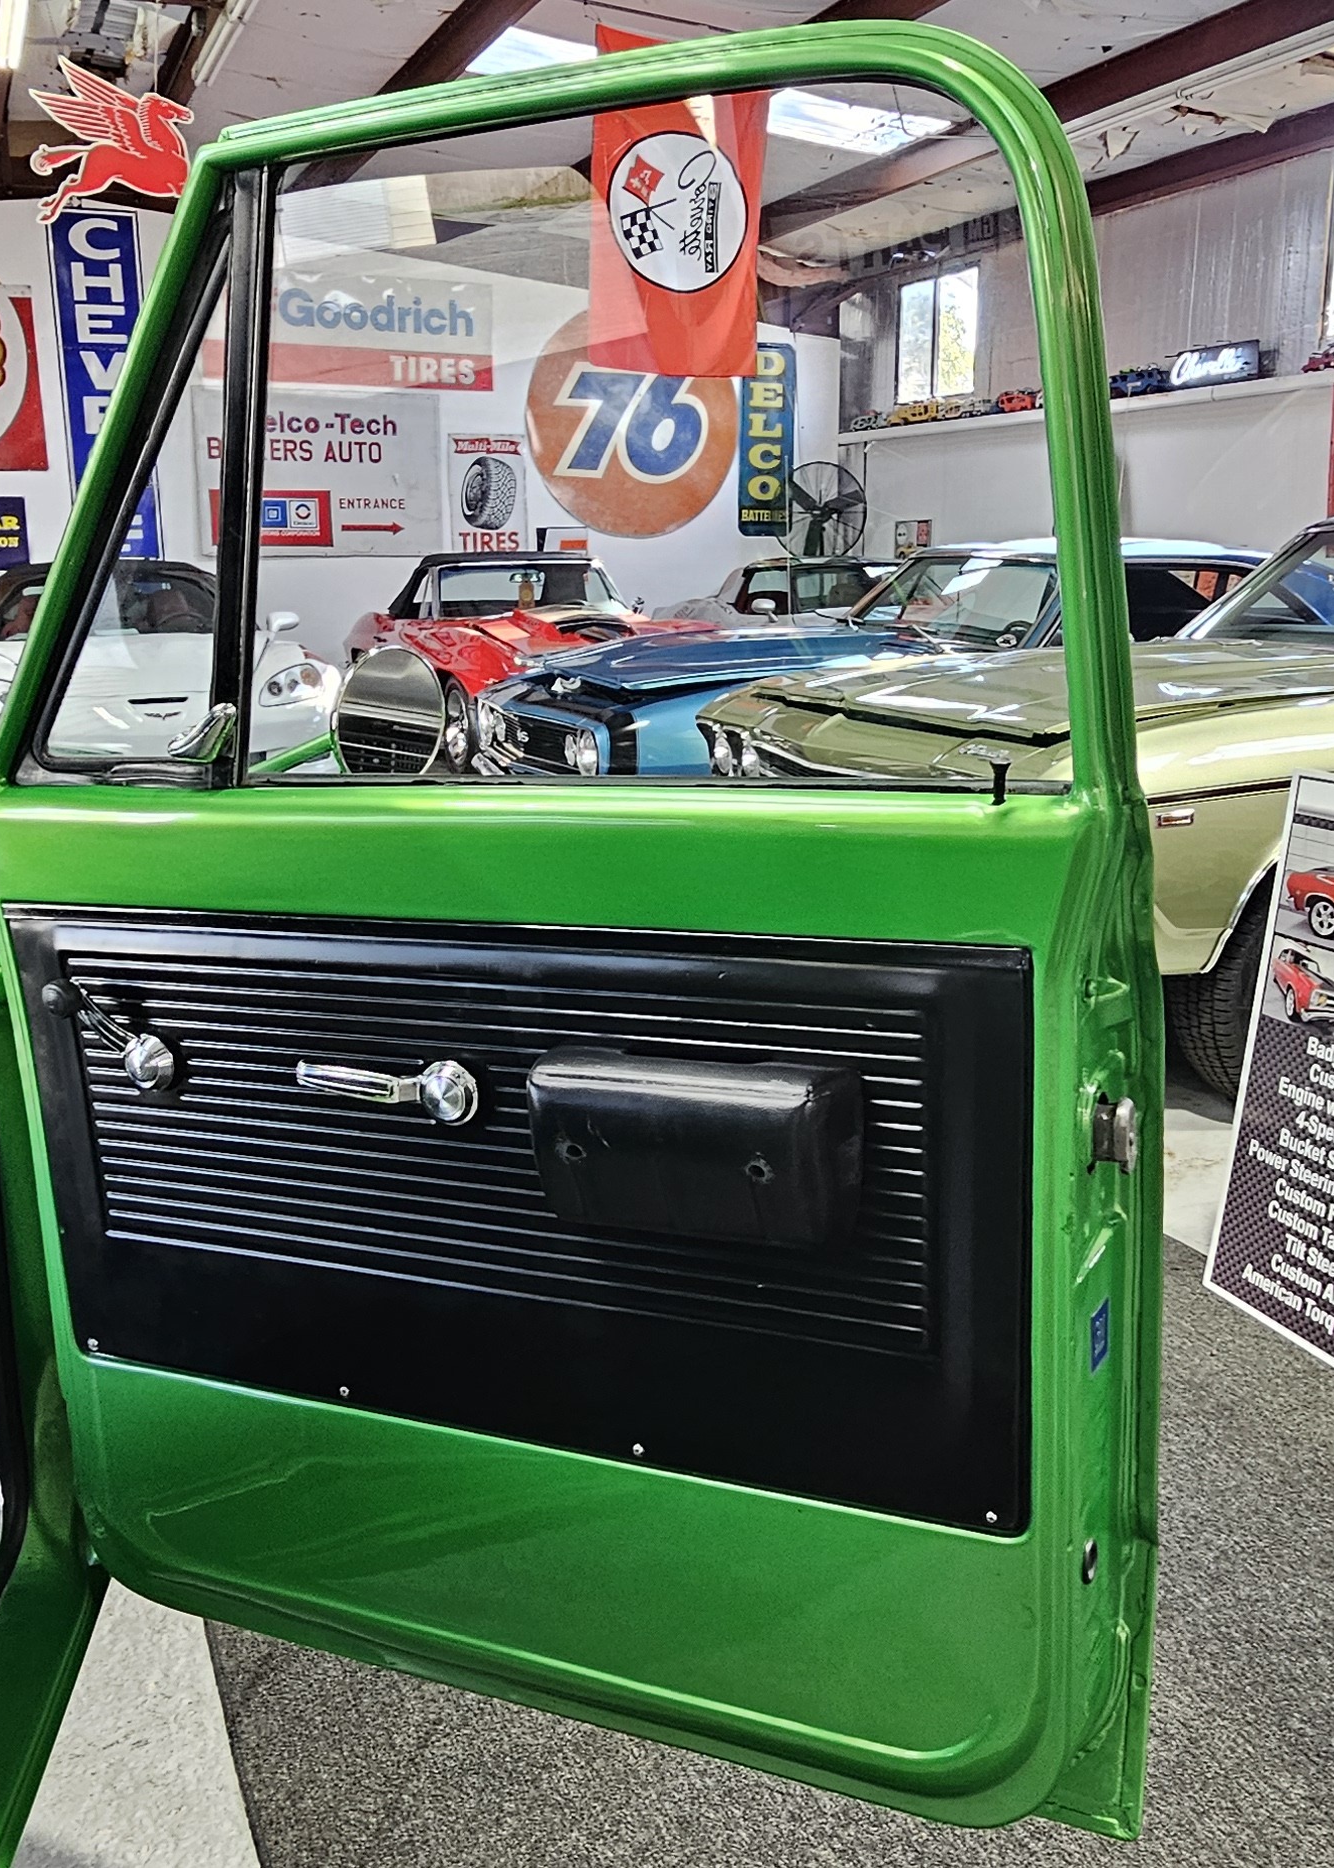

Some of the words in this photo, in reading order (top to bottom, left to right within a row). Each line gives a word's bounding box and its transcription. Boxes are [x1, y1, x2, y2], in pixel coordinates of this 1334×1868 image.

[279, 287, 474, 337] Goodrich
[389, 355, 476, 385] TIRES
[267, 411, 397, 436] elco-Tech
[554, 362, 709, 484] 76
[748, 351, 785, 501] DELCO
[324, 440, 382, 463] AUTO
[339, 497, 406, 510] ENTRANCE
[459, 531, 520, 553] TIRES
[1278, 1076, 1325, 1111] Engine
[1248, 1138, 1290, 1173] Power
[1279, 1127, 1326, 1164] Bucket
[1275, 1177, 1327, 1218] Custom
[1268, 1200, 1319, 1241] Custom
[1285, 1233, 1306, 1256] Tilt
[1241, 1262, 1304, 1312] American
[1270, 1253, 1323, 1297] Custom
